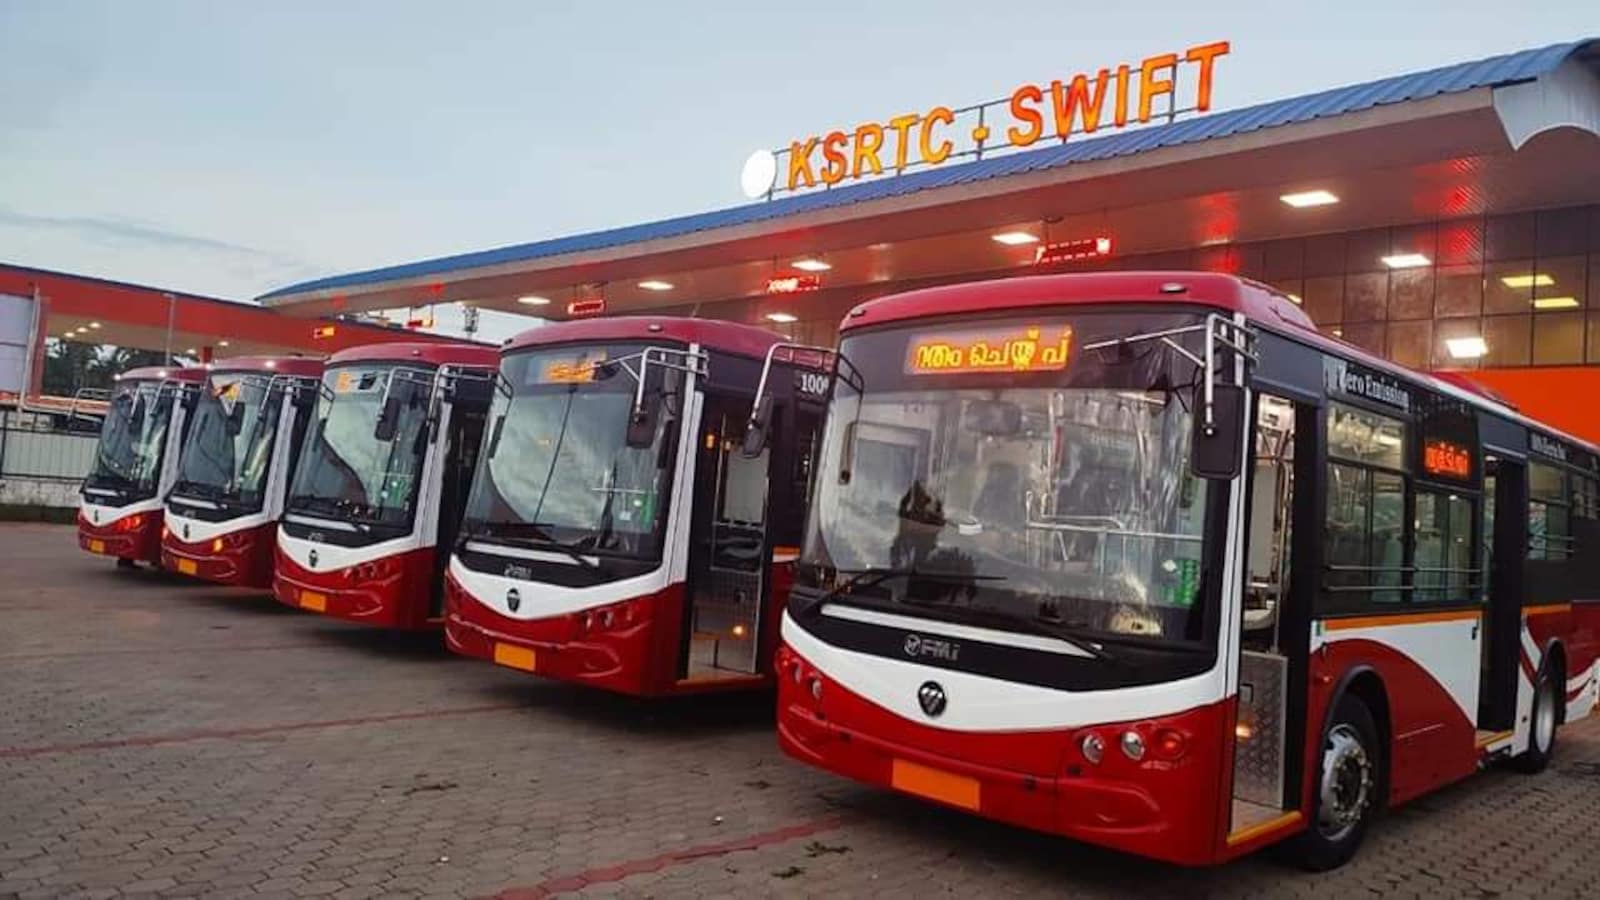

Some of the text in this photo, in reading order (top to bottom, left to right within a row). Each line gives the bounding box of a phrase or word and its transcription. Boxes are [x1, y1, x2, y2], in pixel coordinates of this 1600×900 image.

[786, 106, 954, 191] KSRTC
[1007, 40, 1231, 148] SWIFT
[1365, 375, 1409, 408] Emission
